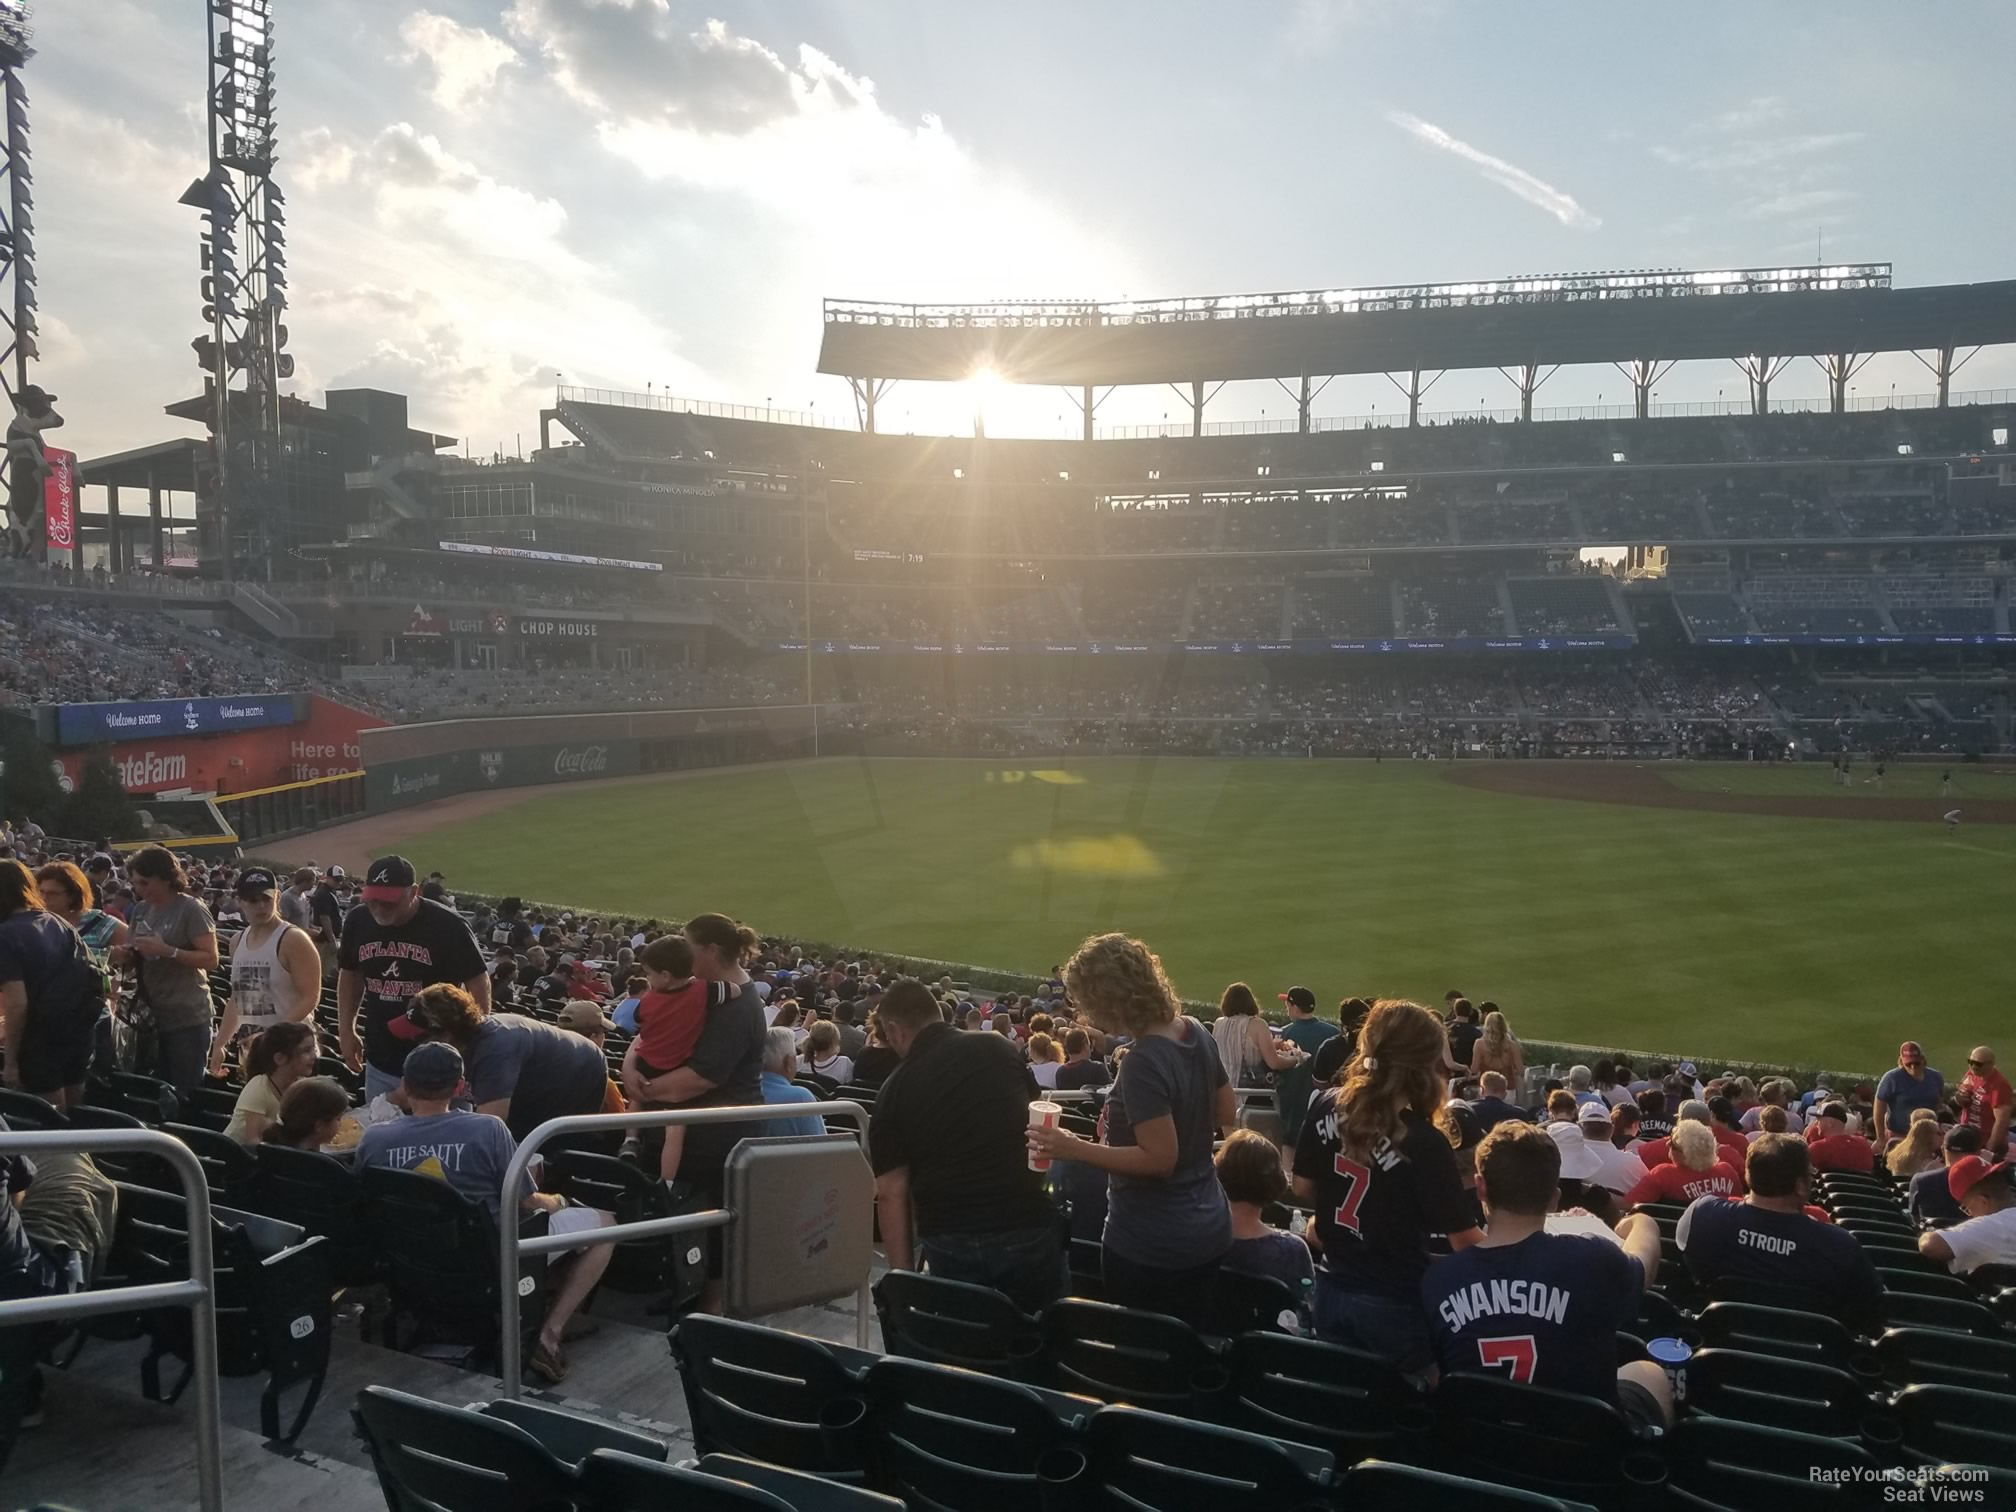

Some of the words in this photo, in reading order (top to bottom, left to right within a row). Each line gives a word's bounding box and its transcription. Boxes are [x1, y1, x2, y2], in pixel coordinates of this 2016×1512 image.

[651, 485, 681, 494] KONICA
[682, 488, 716, 497] MINOLTA
[908, 553, 924, 563] 7:19
[450, 619, 483, 632] LIGHT
[520, 621, 554, 635] CHOP
[558, 623, 598, 636] HOUSE
[106, 712, 137, 728] Welcome
[220, 704, 244, 720] Welcome
[291, 741, 336, 758] Here
[342, 742, 360, 758] to
[480, 753, 502, 762] MLB
[117, 751, 186, 788] ateFarm
[358, 941, 433, 966] ATLANTA
[365, 977, 423, 996] BRAVES
[386, 1146, 417, 1169] THE
[418, 1143, 467, 1172] SALTY
[1334, 1152, 1371, 1232] 7
[1682, 1177, 1734, 1199] FREEMAN
[1737, 1229, 1797, 1257] STROUP
[1439, 1279, 1571, 1334] SWANSON
[295, 1320, 310, 1336] 26
[1477, 1334, 1538, 1384] 7
